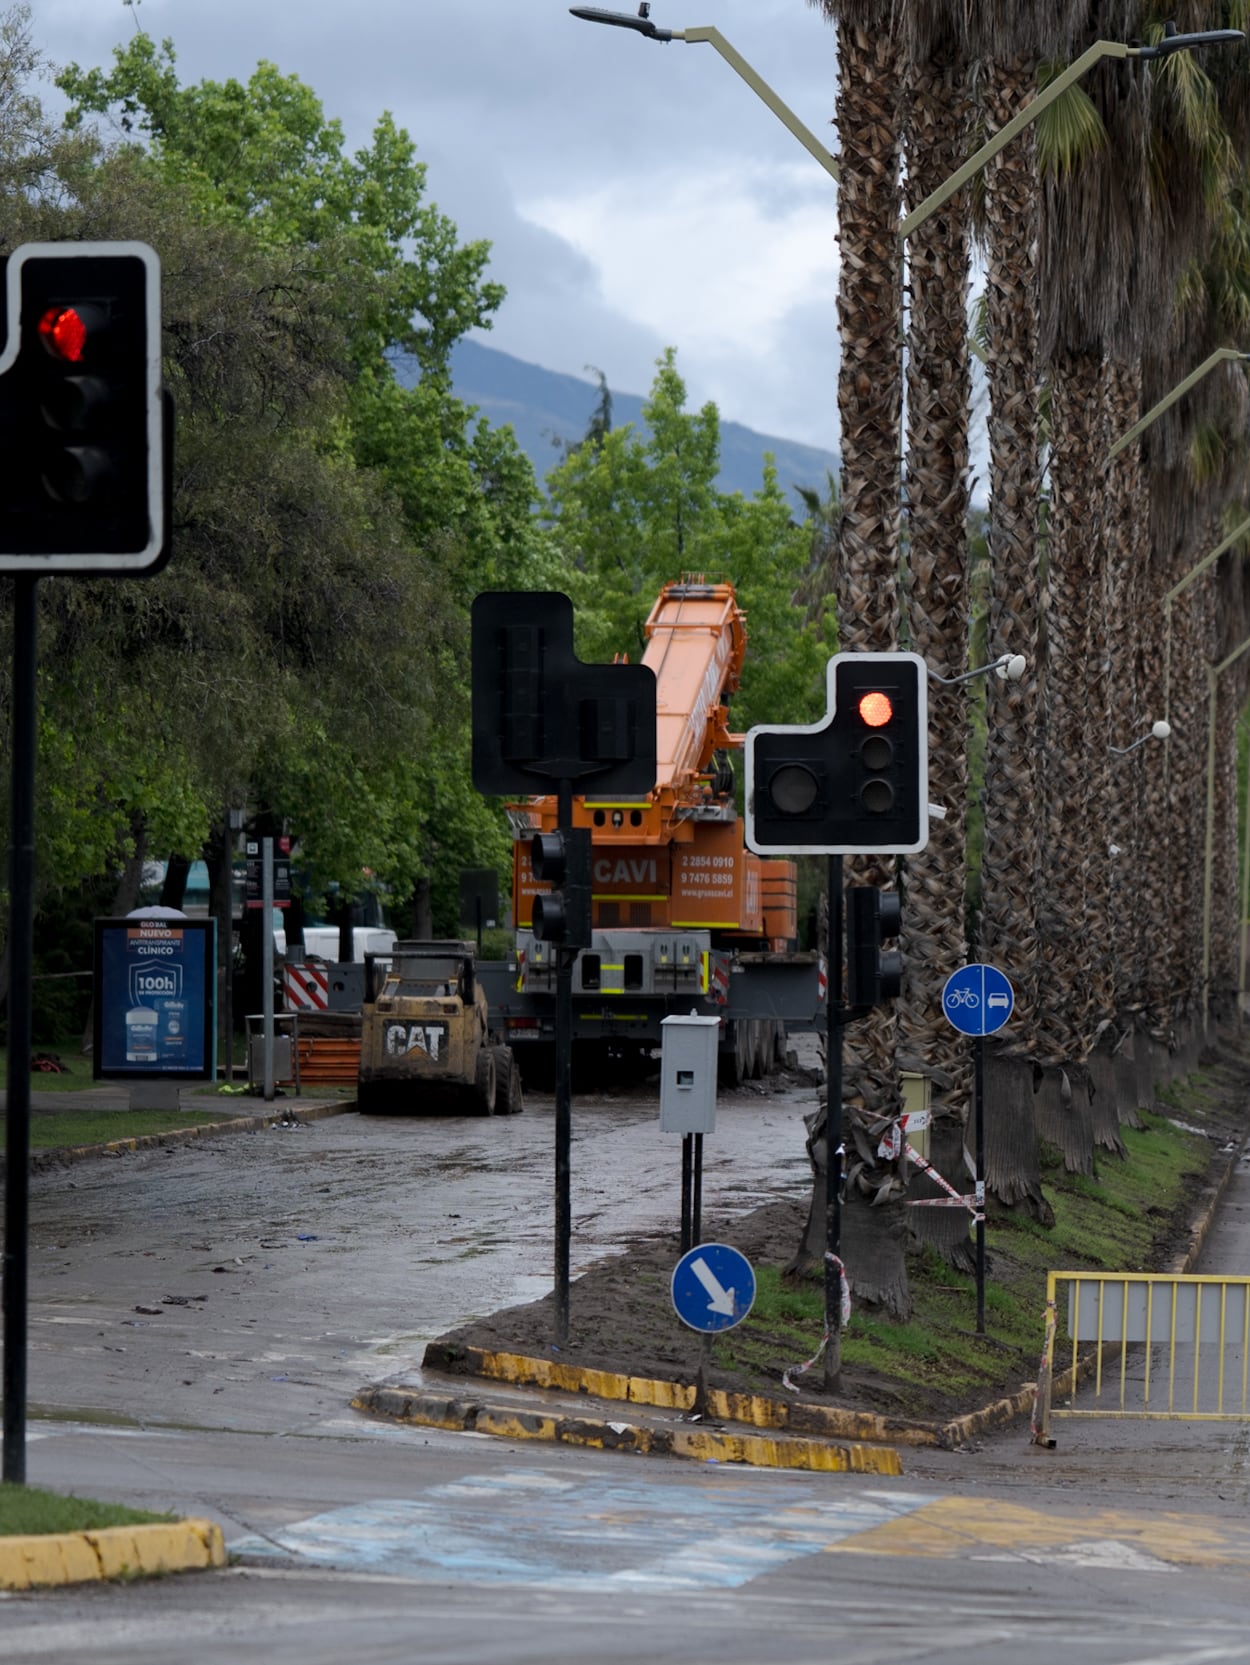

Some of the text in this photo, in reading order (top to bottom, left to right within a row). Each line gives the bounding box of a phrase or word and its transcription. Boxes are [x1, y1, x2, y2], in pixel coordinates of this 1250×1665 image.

[682, 856, 734, 868] 2 2854 0910
[594, 859, 656, 883] CAVI
[521, 872, 527, 883] 9
[681, 872, 688, 884] 9
[689, 872, 710, 884] 7476
[140, 929, 172, 937] NUEVO
[137, 946, 174, 955] CLÍNICO
[139, 976, 173, 990] 100h
[387, 1025, 444, 1061] CAT
